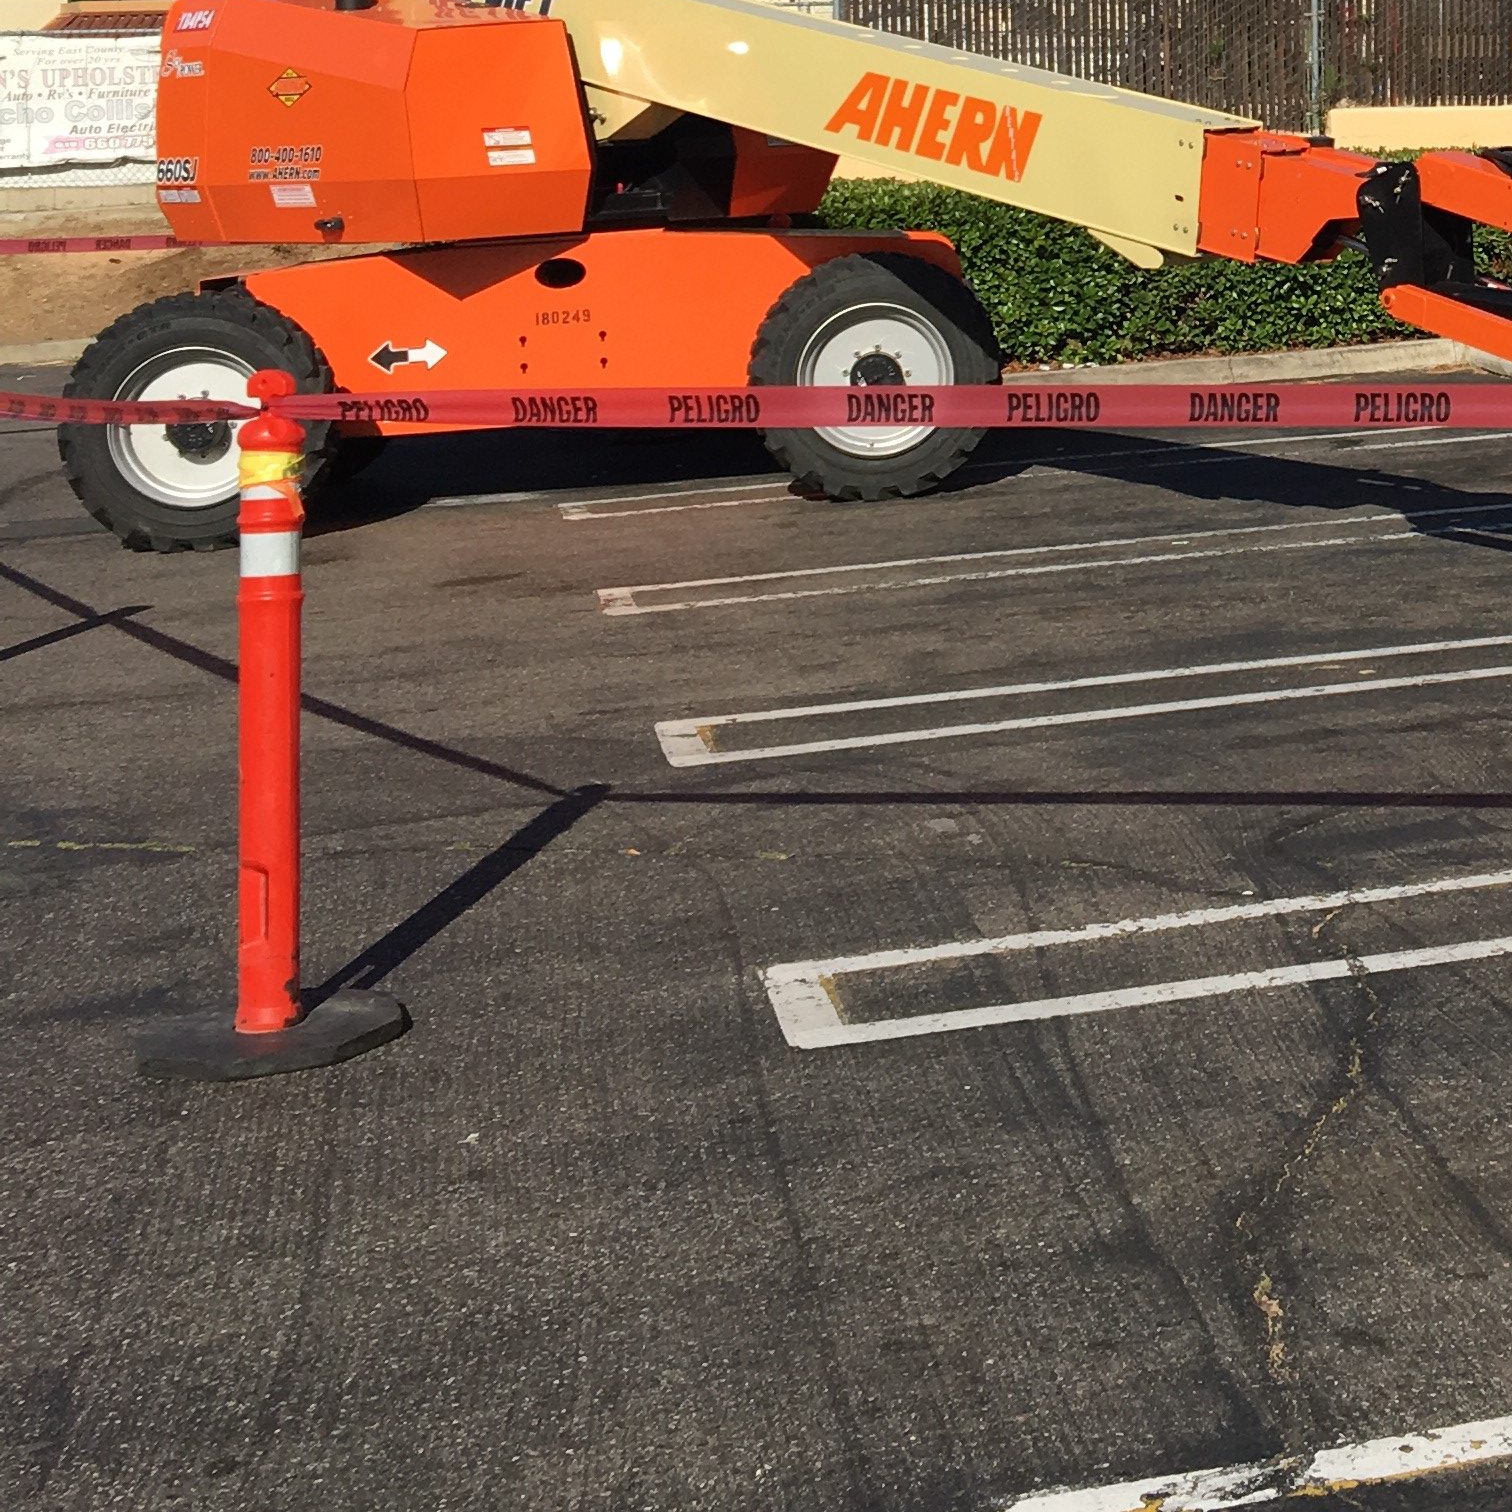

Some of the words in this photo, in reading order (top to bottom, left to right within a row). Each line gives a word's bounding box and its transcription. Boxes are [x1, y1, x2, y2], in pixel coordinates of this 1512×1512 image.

[4, 91, 33, 102] Auto
[87, 88, 151, 99] Furniture
[69, 125, 103, 135] Auto
[824, 72, 1044, 183] AHERN
[250, 146, 322, 164] 800-400-1610
[157, 159, 198, 183] 660SJ
[249, 166, 321, 181] www.AHERN.com
[534, 309, 592, 327] 180249
[511, 396, 599, 424] DANGER
[668, 394, 760, 423] PELIGRO
[847, 393, 935, 423] DANGER
[1006, 392, 1100, 422] PELIGRO
[1188, 392, 1281, 423] DANGER
[1353, 392, 1451, 423] PELIGRO
